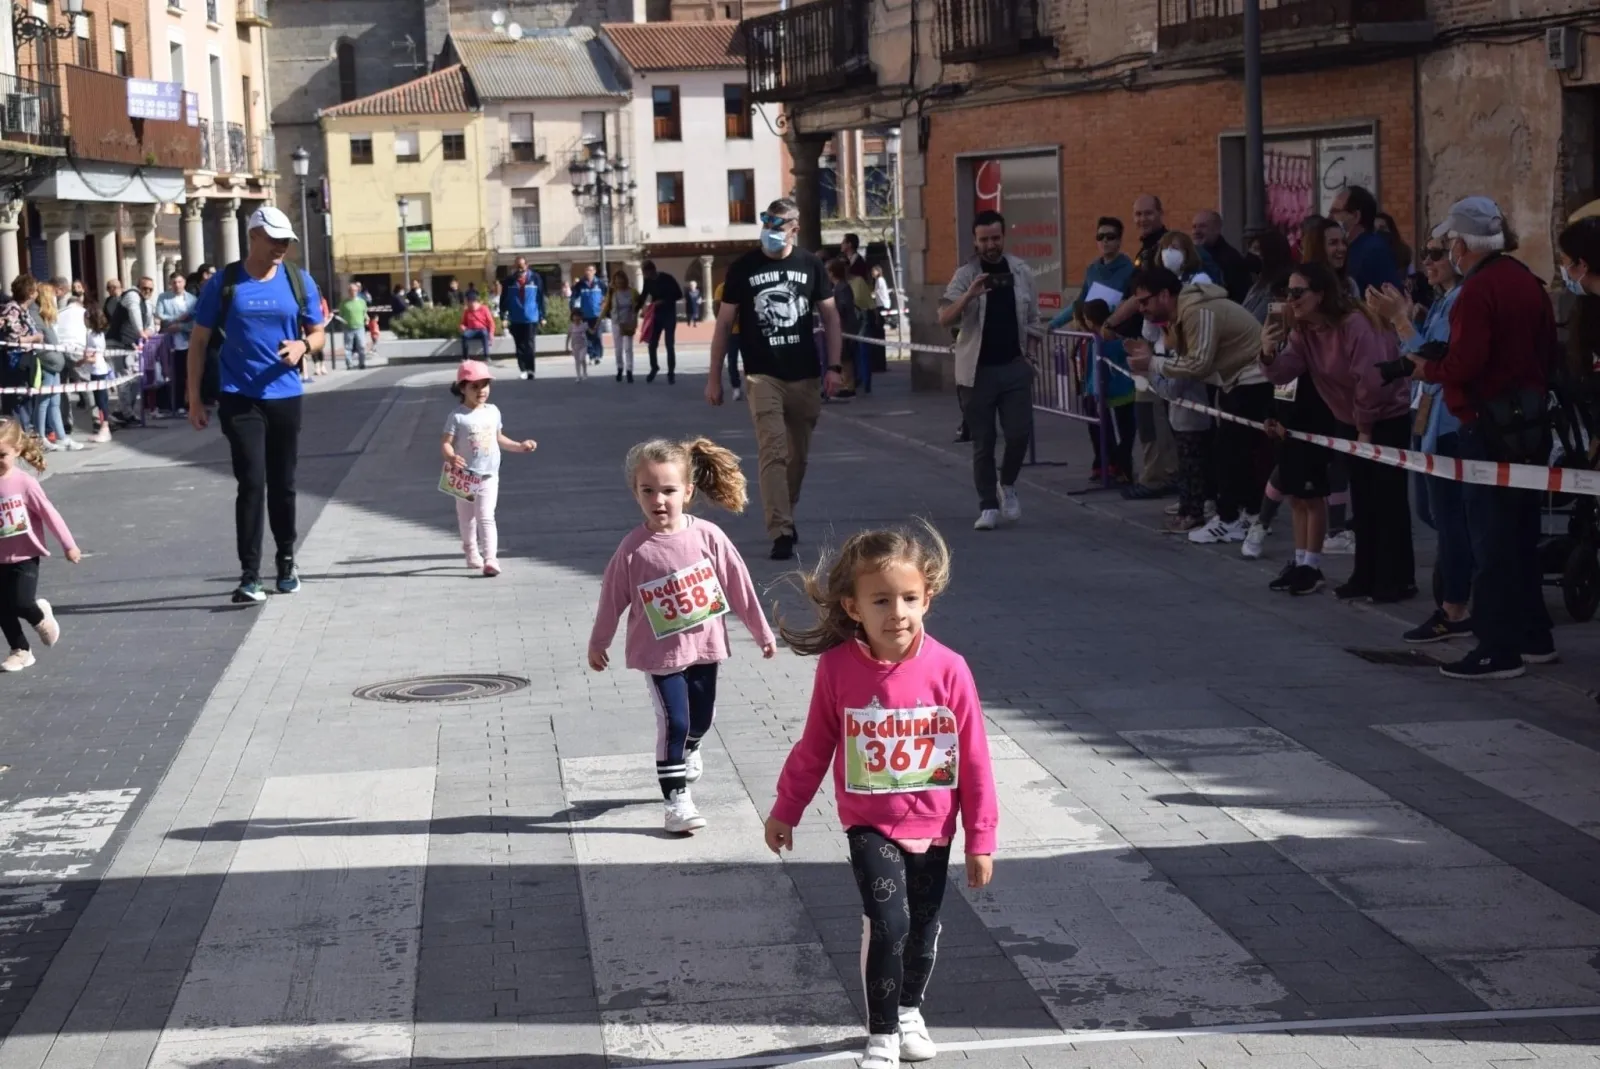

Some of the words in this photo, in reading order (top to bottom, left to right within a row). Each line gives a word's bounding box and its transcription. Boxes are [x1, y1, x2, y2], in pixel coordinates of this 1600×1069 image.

[786, 270, 808, 285] WILD
[448, 475, 471, 493] 365
[639, 566, 713, 604] bedunia
[660, 586, 708, 621] 358
[846, 711, 955, 738] bedunia
[865, 737, 935, 773] 367
